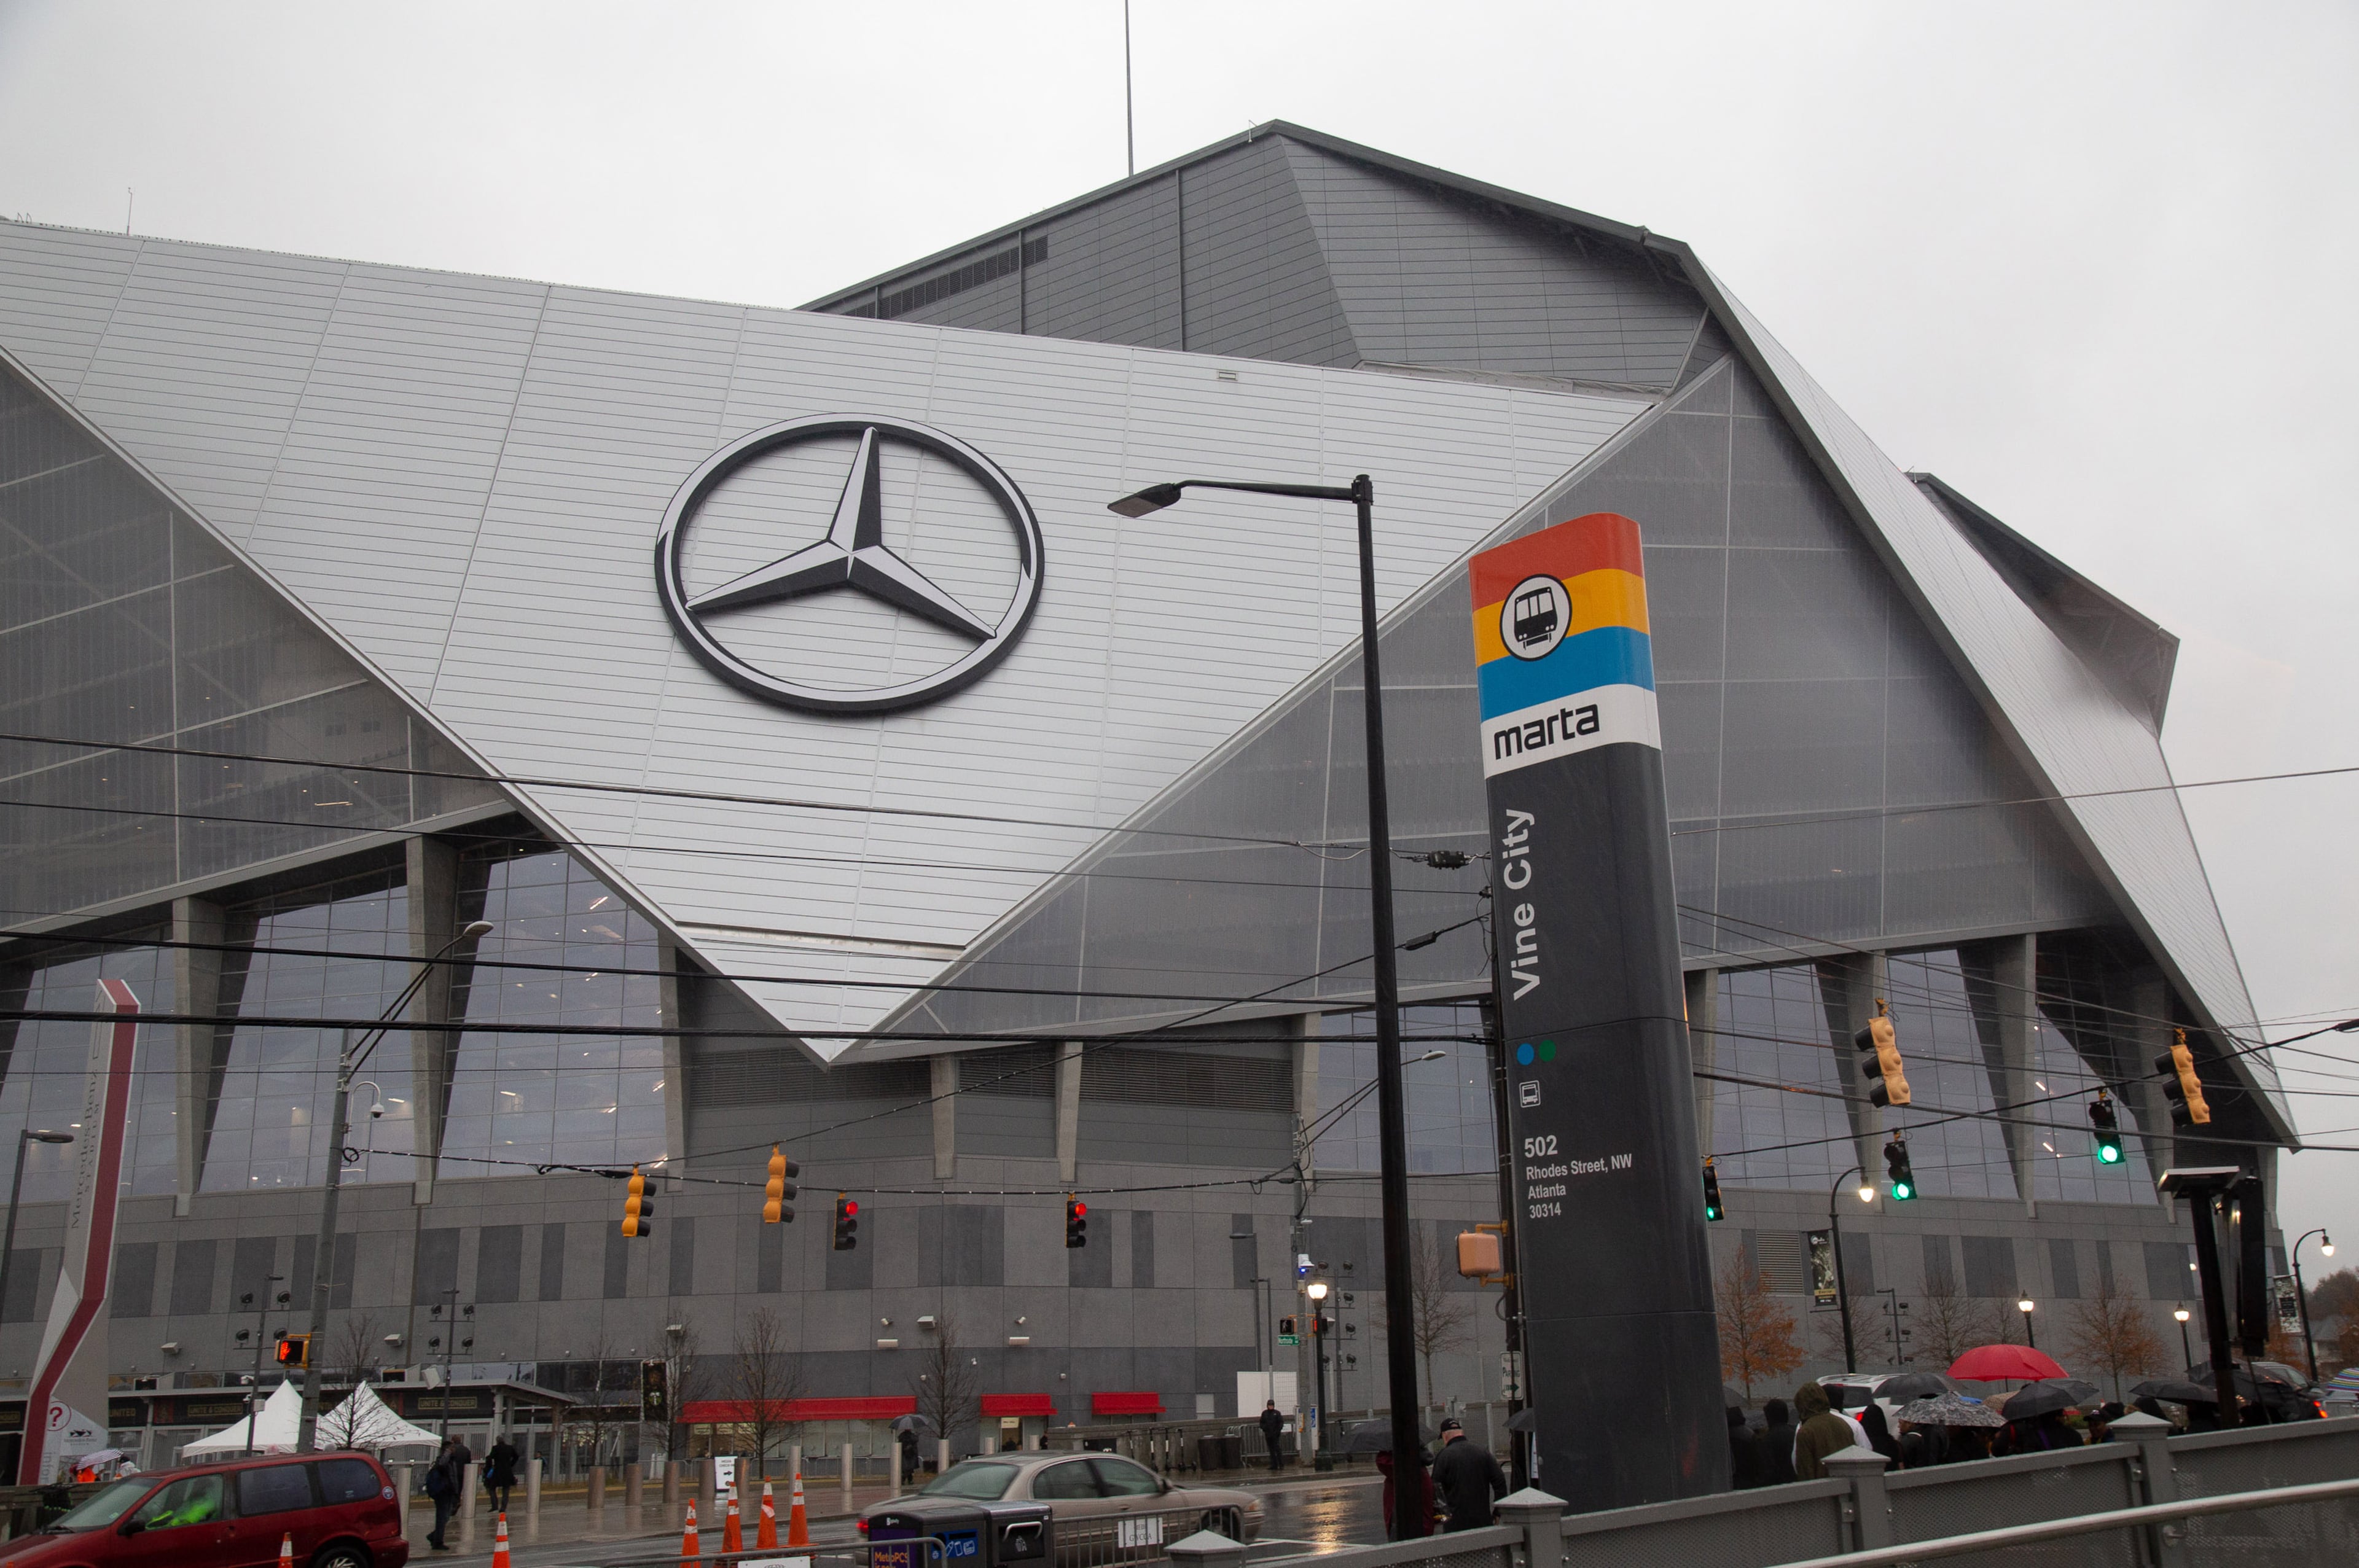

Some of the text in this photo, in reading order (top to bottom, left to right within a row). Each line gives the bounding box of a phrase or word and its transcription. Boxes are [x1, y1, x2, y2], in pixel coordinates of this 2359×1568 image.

[1494, 704, 1600, 760] marta
[1502, 809, 1540, 1000] Vine City
[72, 1069, 97, 1228] Mercedes-Benz
[1524, 1135, 1558, 1158] 502
[1526, 1153, 1632, 1180] Rhodes Street, NW
[1528, 1183, 1566, 1199] Atlanta
[1530, 1202, 1561, 1219] 30314
[875, 1551, 908, 1563] MetoPCS
